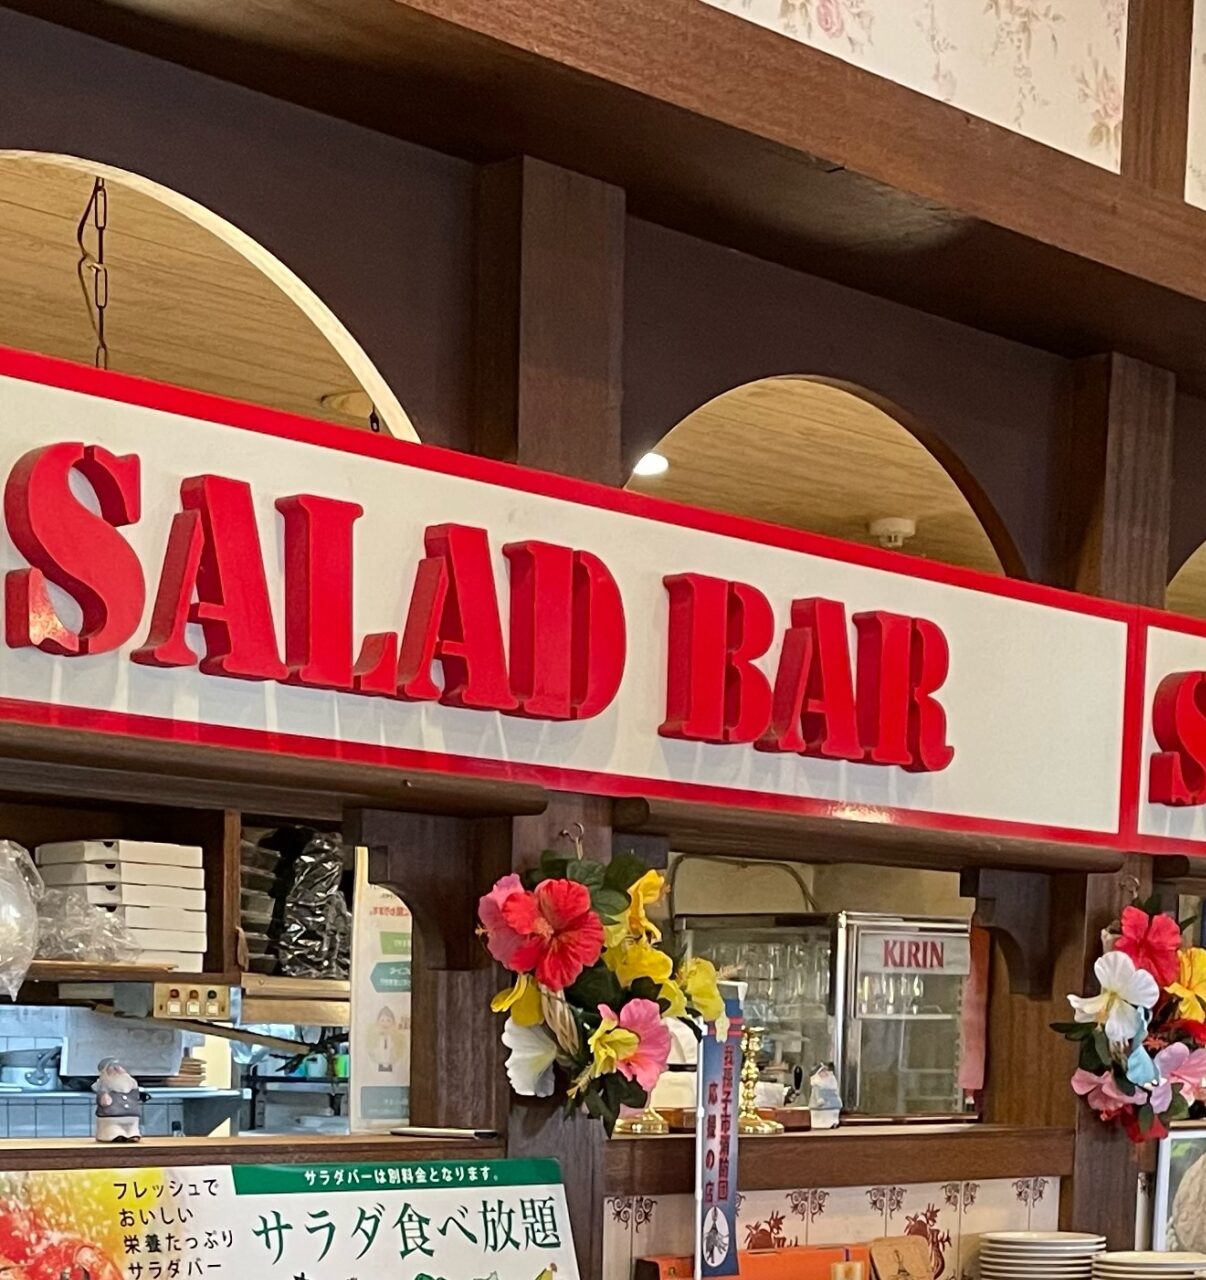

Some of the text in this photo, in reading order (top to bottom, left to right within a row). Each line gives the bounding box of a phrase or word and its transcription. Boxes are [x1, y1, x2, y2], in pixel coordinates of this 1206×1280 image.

[4, 441, 955, 773] SALAD BAR
[883, 939, 945, 968] KIRIN
[304, 1166, 499, 1187] サラダバーは別料金となります。
[113, 1178, 219, 1200] フレッシュで
[119, 1206, 194, 1227] おいしい
[124, 1230, 234, 1254] 栄養たっぷり
[252, 1195, 562, 1266] サラダ食べ放題
[128, 1258, 223, 1280] サラダバー
